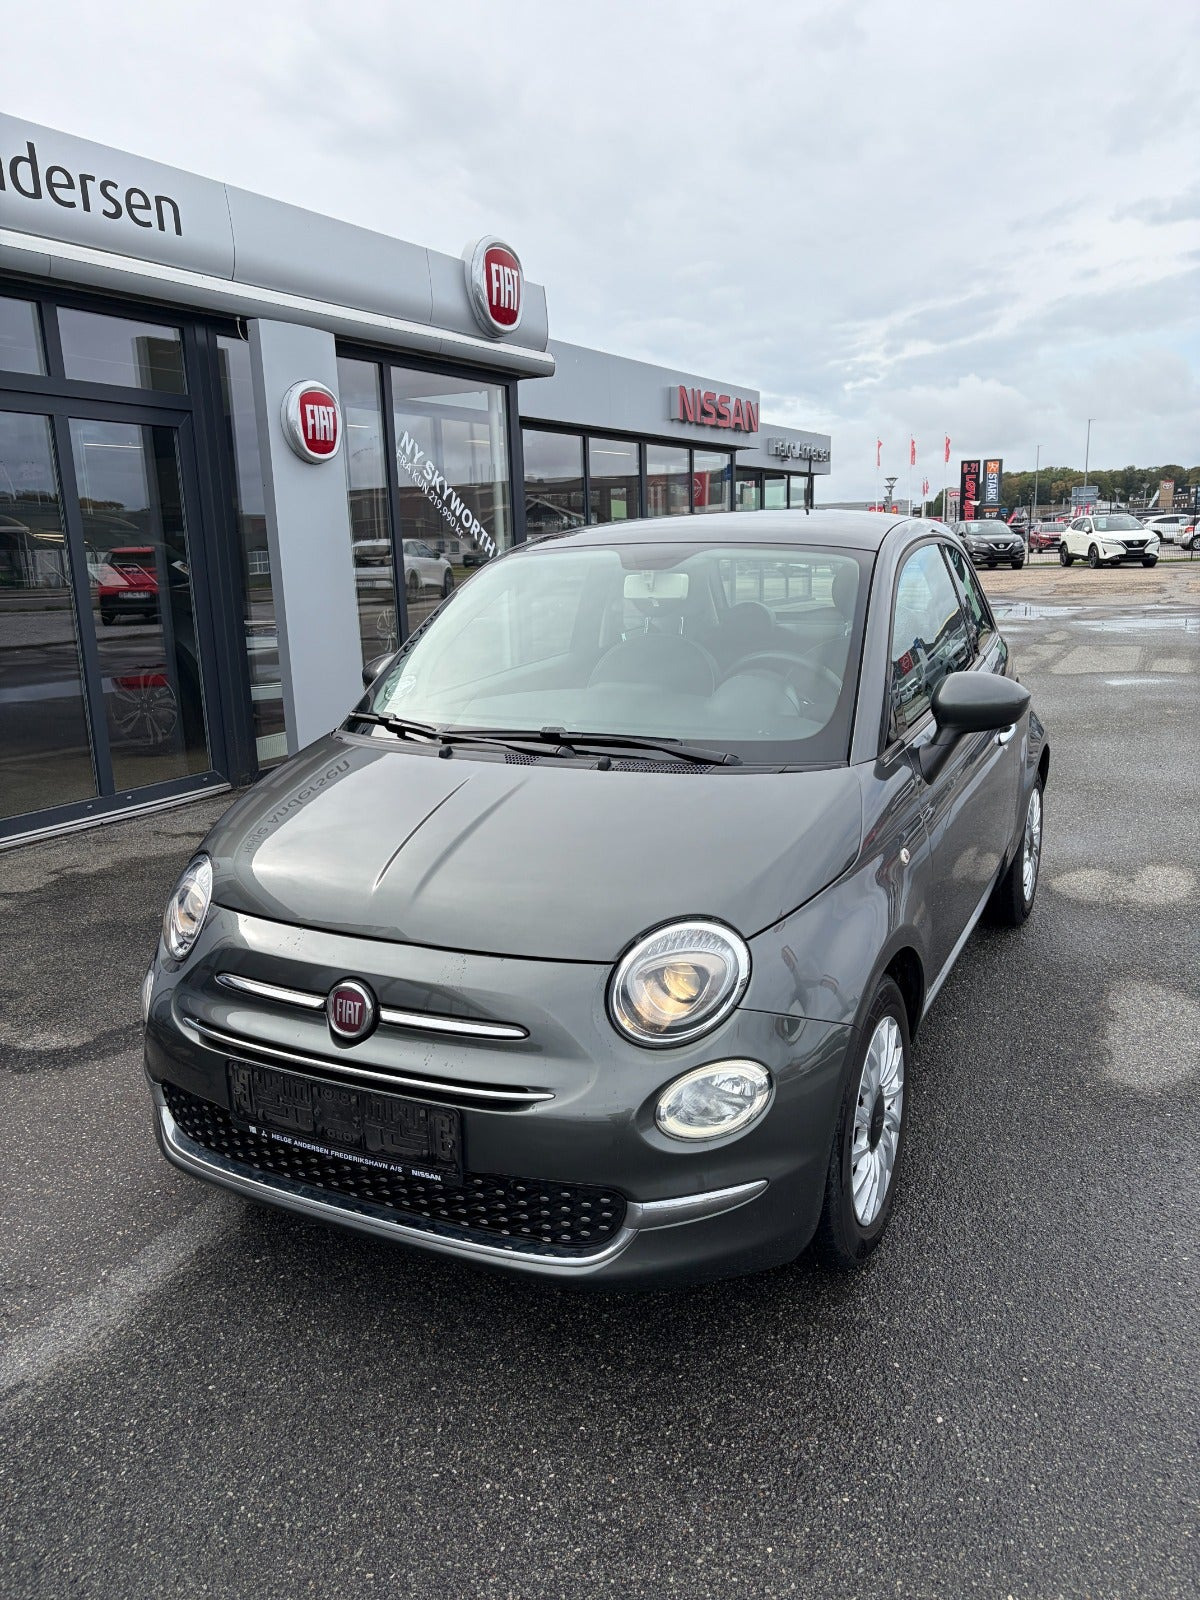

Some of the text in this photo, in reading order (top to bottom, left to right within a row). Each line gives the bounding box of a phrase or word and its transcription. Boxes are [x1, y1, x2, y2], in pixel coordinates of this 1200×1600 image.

[0, 140, 183, 237] dersen
[490, 262, 519, 311] FIAT
[305, 404, 335, 442] FIAT
[679, 385, 759, 432] NISSAN
[396, 449, 412, 474] FRA
[411, 468, 430, 495] KUN
[428, 490, 457, 527] 219.990
[400, 430, 496, 559] NY SKYWORTH
[987, 473, 998, 501] STARK
[336, 998, 362, 1025] FIAT
[293, 1139, 329, 1155] ANDERSEN
[330, 1149, 388, 1170] FREDERIKSHAVN
[411, 1169, 442, 1182] NISSAN
